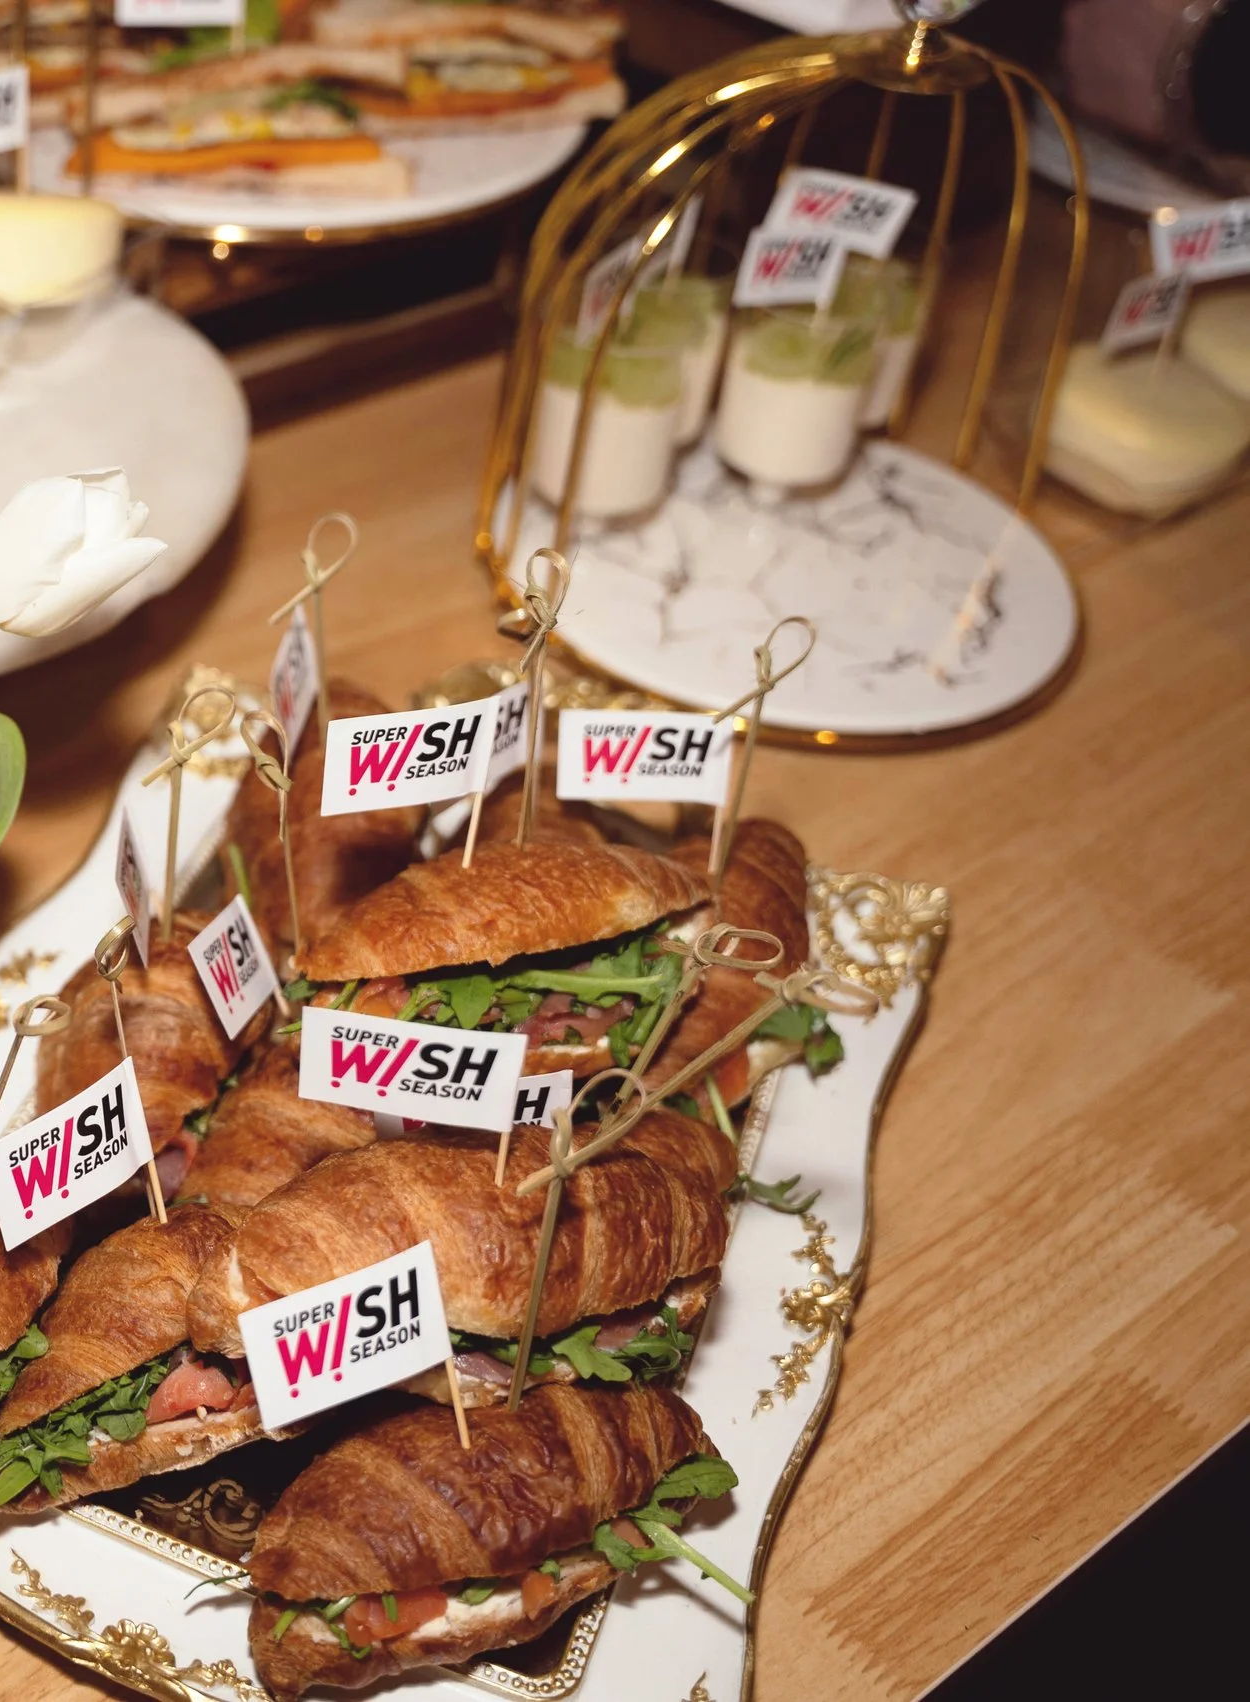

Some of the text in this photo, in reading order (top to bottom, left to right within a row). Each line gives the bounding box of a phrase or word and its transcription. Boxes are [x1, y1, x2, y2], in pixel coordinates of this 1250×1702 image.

[351, 727, 408, 745] SUPER
[583, 724, 637, 737] SUPER
[405, 756, 469, 779] SEASON
[637, 762, 702, 777] SEASON
[331, 1026, 400, 1049] SUPER
[398, 1078, 484, 1101] SEASON
[9, 1127, 61, 1168] SUPER
[74, 1131, 128, 1180] SEASON
[274, 1302, 335, 1338] SUPER
[350, 1319, 421, 1363] SEASON
